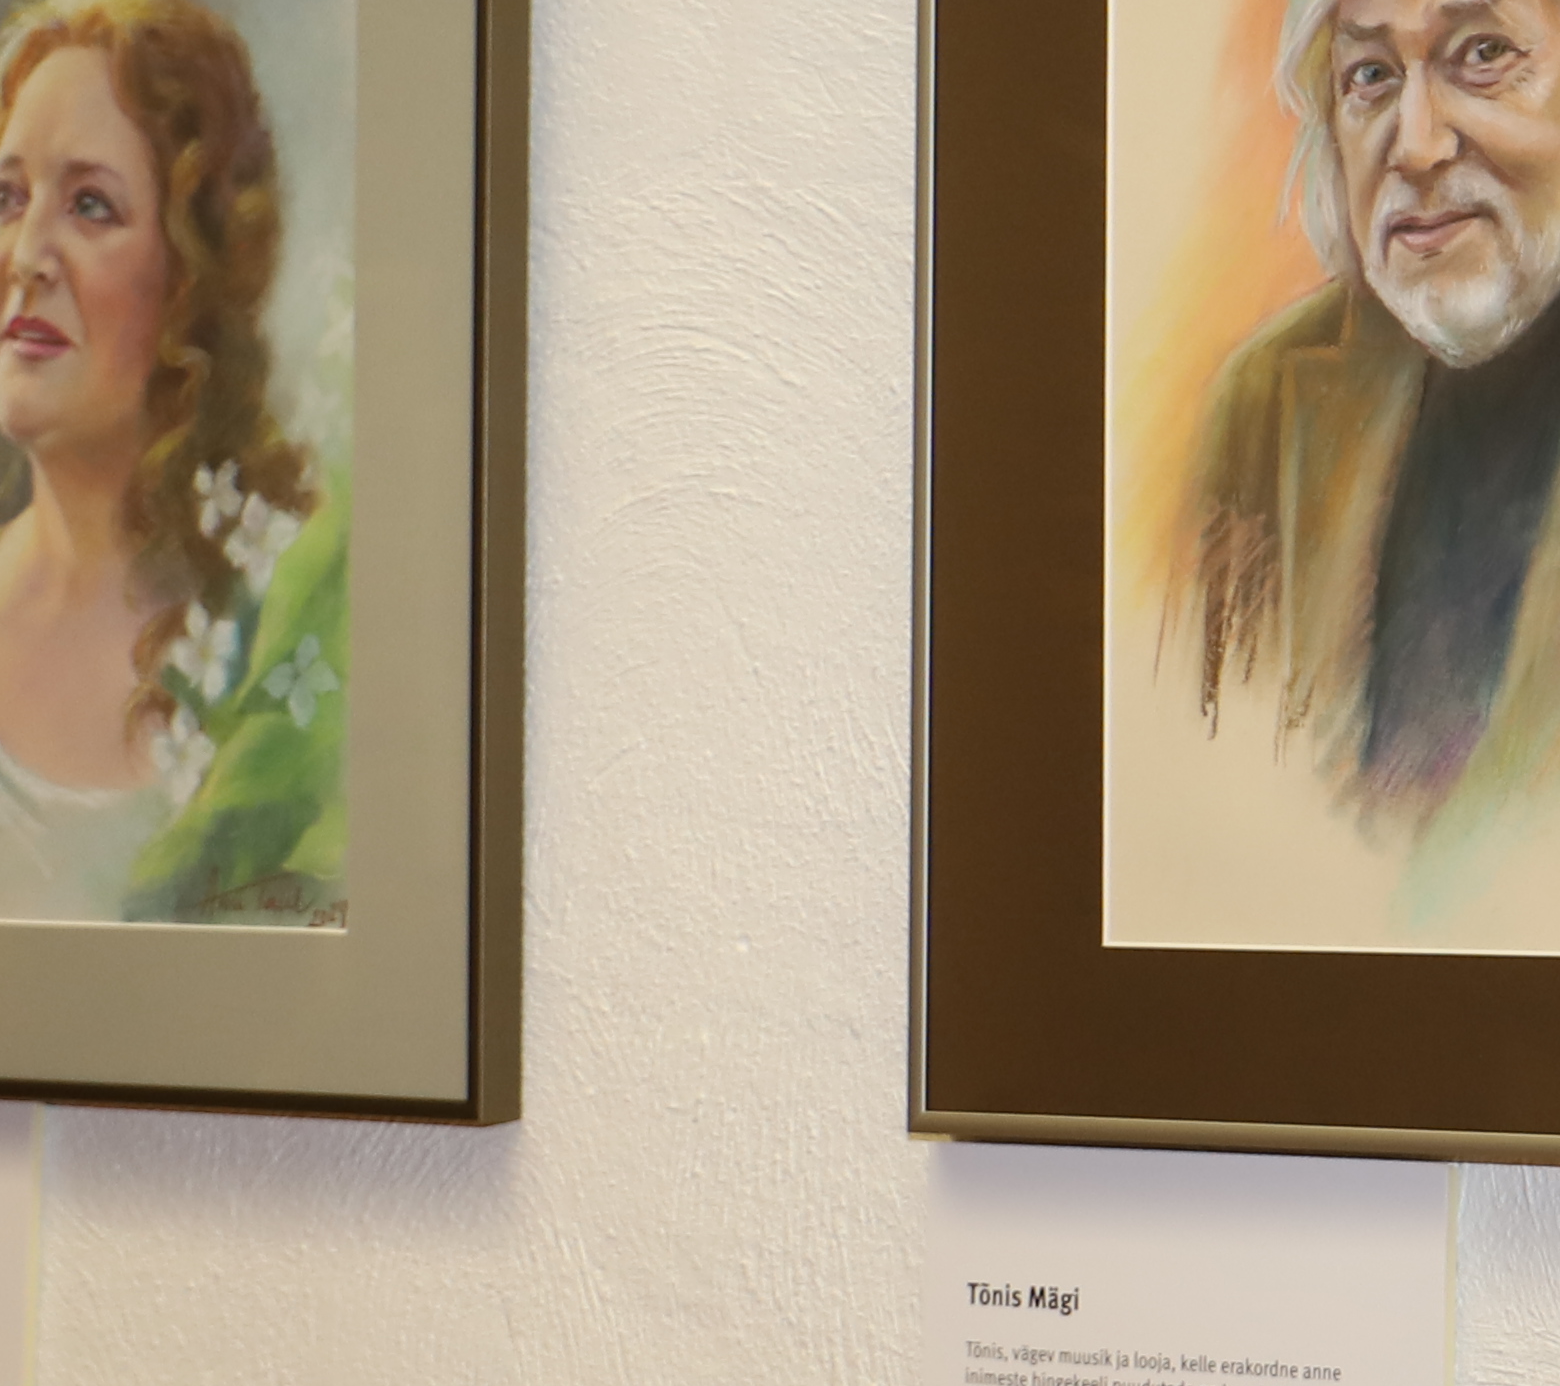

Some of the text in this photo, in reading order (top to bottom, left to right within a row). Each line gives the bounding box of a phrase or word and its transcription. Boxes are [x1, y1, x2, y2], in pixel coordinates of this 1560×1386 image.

[965, 1280, 1080, 1316] Tõnis Mägi
[965, 1339, 1342, 1382] Tõnis, vägev muusik ja looja, kelle erakordne anne
